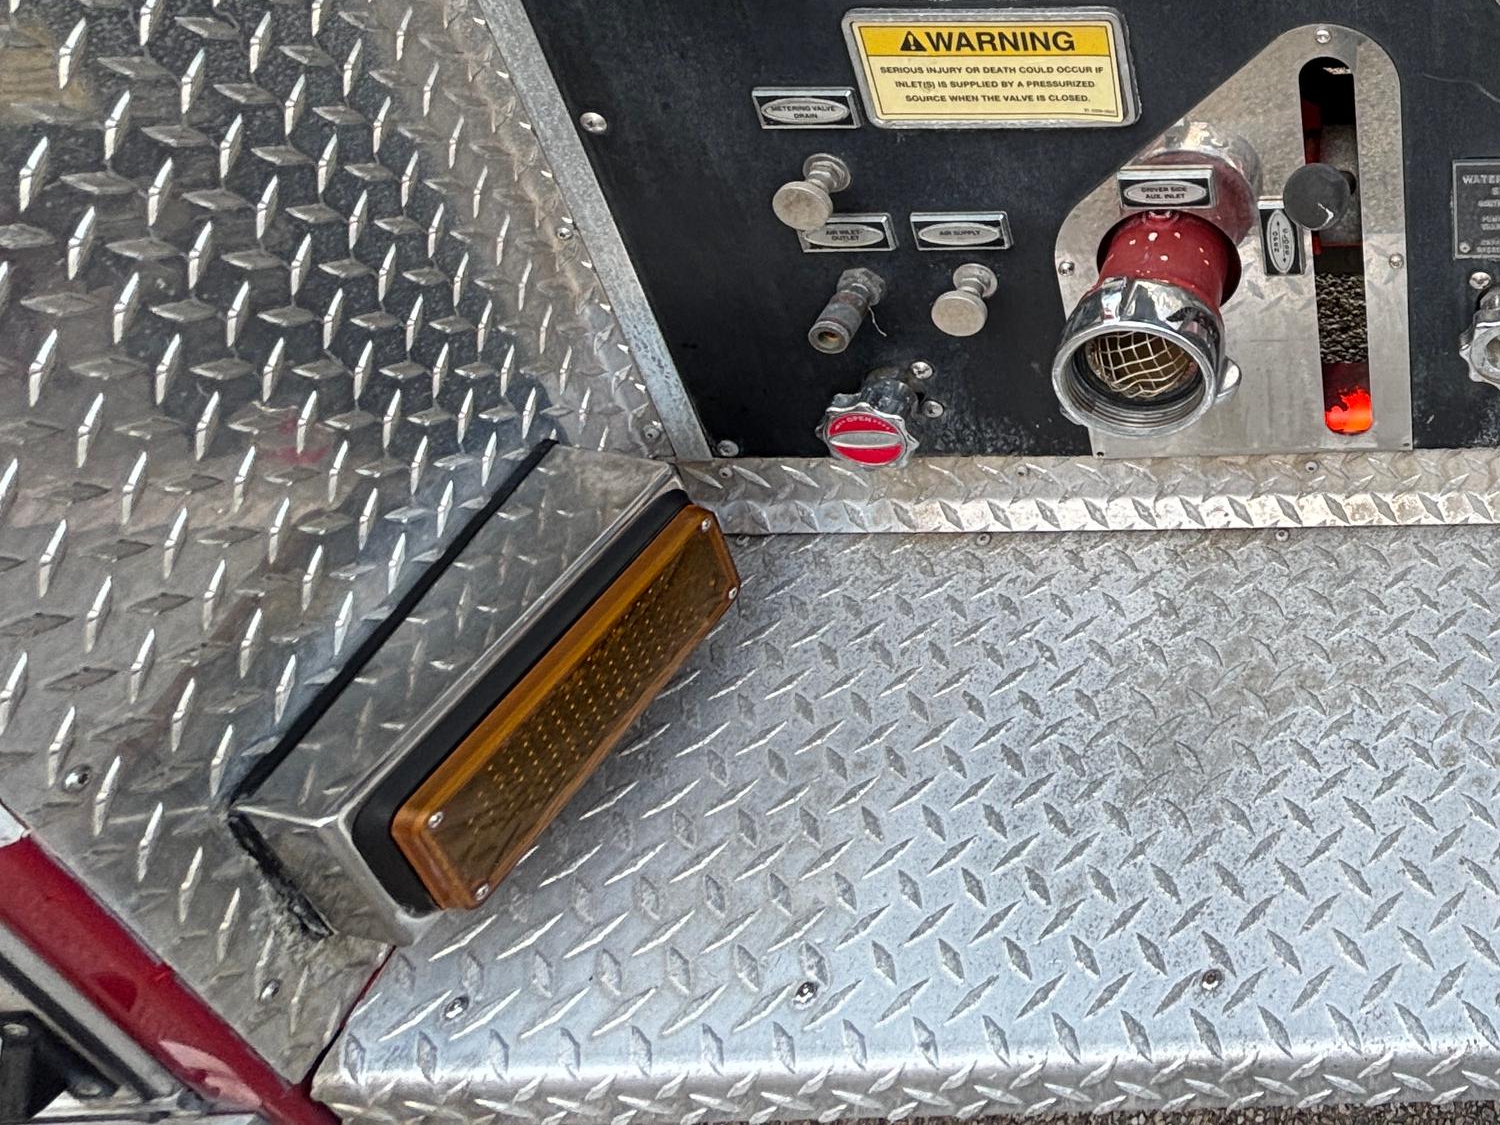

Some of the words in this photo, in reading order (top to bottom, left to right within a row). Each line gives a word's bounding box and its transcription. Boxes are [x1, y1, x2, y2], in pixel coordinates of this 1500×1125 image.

[924, 31, 1075, 51] WARNING
[880, 66, 924, 74] SERIOUS
[927, 66, 962, 74] INJURY
[967, 66, 980, 74] OR
[983, 66, 1016, 74] DEATH
[1019, 66, 1053, 74] COULD
[1056, 66, 1091, 74] OCCUR
[1095, 66, 1103, 74] IF
[895, 80, 935, 89] INLET(S)
[938, 81, 947, 89] IS
[950, 81, 999, 89] SUPPLIED
[1002, 81, 1014, 89] BY
[1017, 81, 1024, 89] A
[1027, 81, 1094, 89] PRESSURIZED
[906, 95, 947, 103] SOURCE
